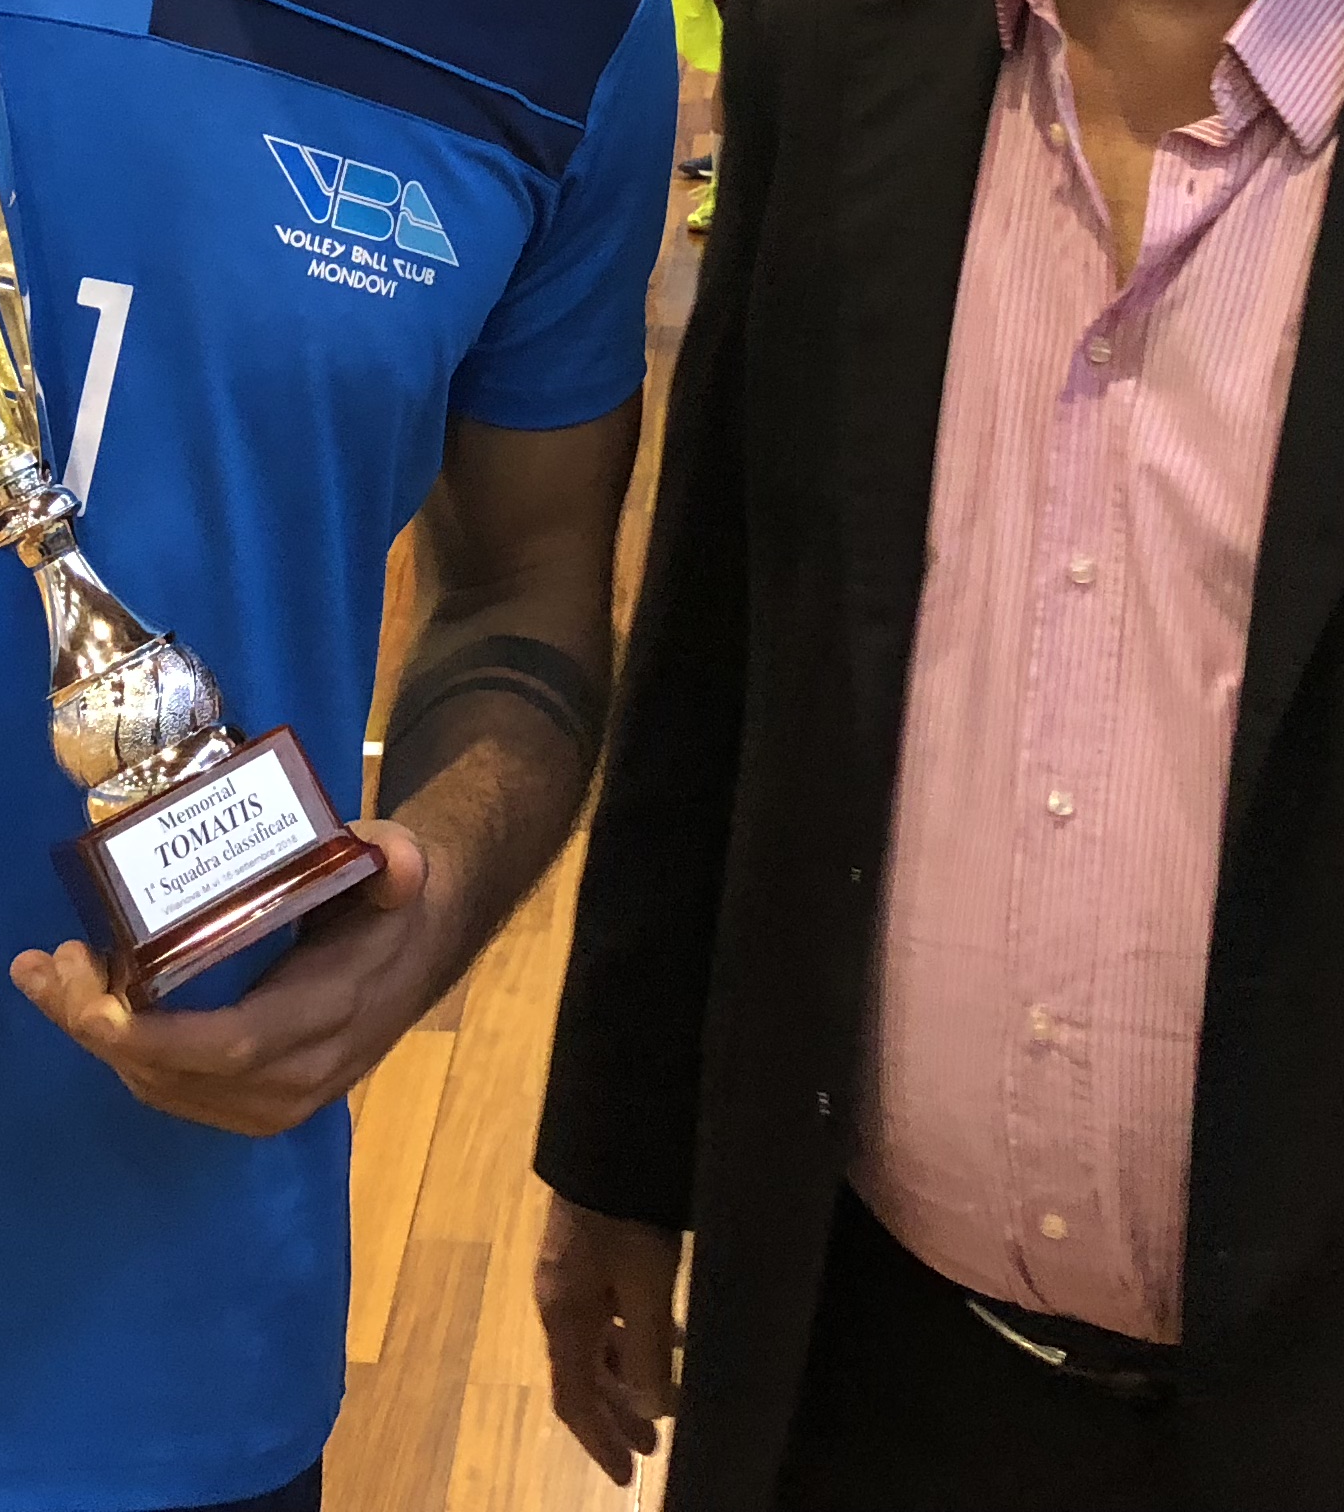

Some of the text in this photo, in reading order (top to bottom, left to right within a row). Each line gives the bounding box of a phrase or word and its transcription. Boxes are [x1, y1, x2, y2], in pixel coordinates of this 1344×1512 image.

[274, 224, 437, 287] VOLLEY BALL CLUB
[154, 792, 263, 868] TOMATIS
[157, 778, 236, 833] Memorial
[159, 856, 221, 894] Squadra
[222, 812, 298, 861] classificata
